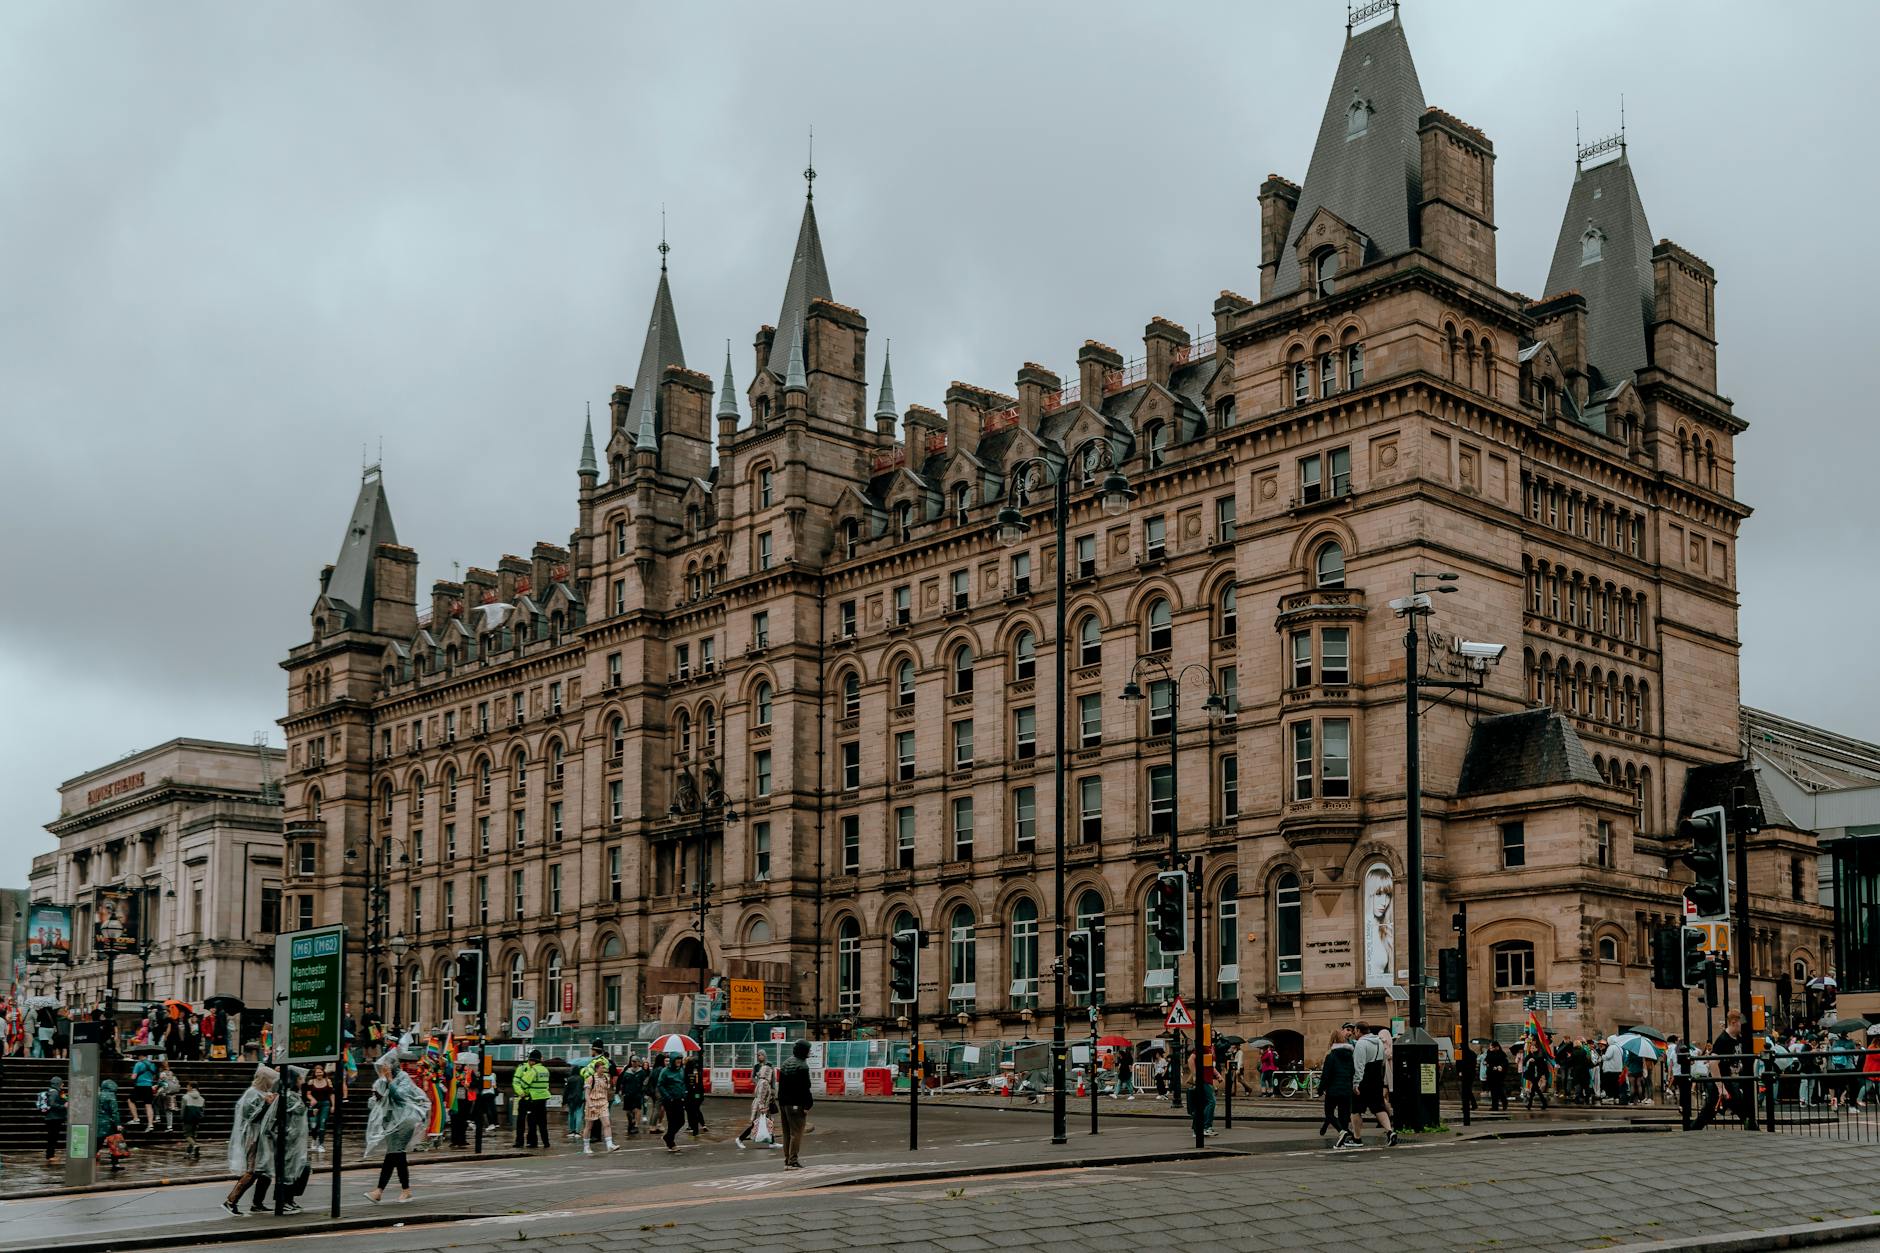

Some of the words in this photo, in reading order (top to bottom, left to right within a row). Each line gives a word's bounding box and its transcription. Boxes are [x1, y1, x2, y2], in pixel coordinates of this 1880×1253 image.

[294, 942, 312, 957] (M6)
[315, 938, 337, 954] (M62)
[292, 965, 327, 978] Manchester
[292, 980, 326, 992] Warrington
[733, 985, 760, 993] CLIMAX
[291, 998, 319, 1009] Wallasey
[291, 1010, 326, 1024] Birkenhead
